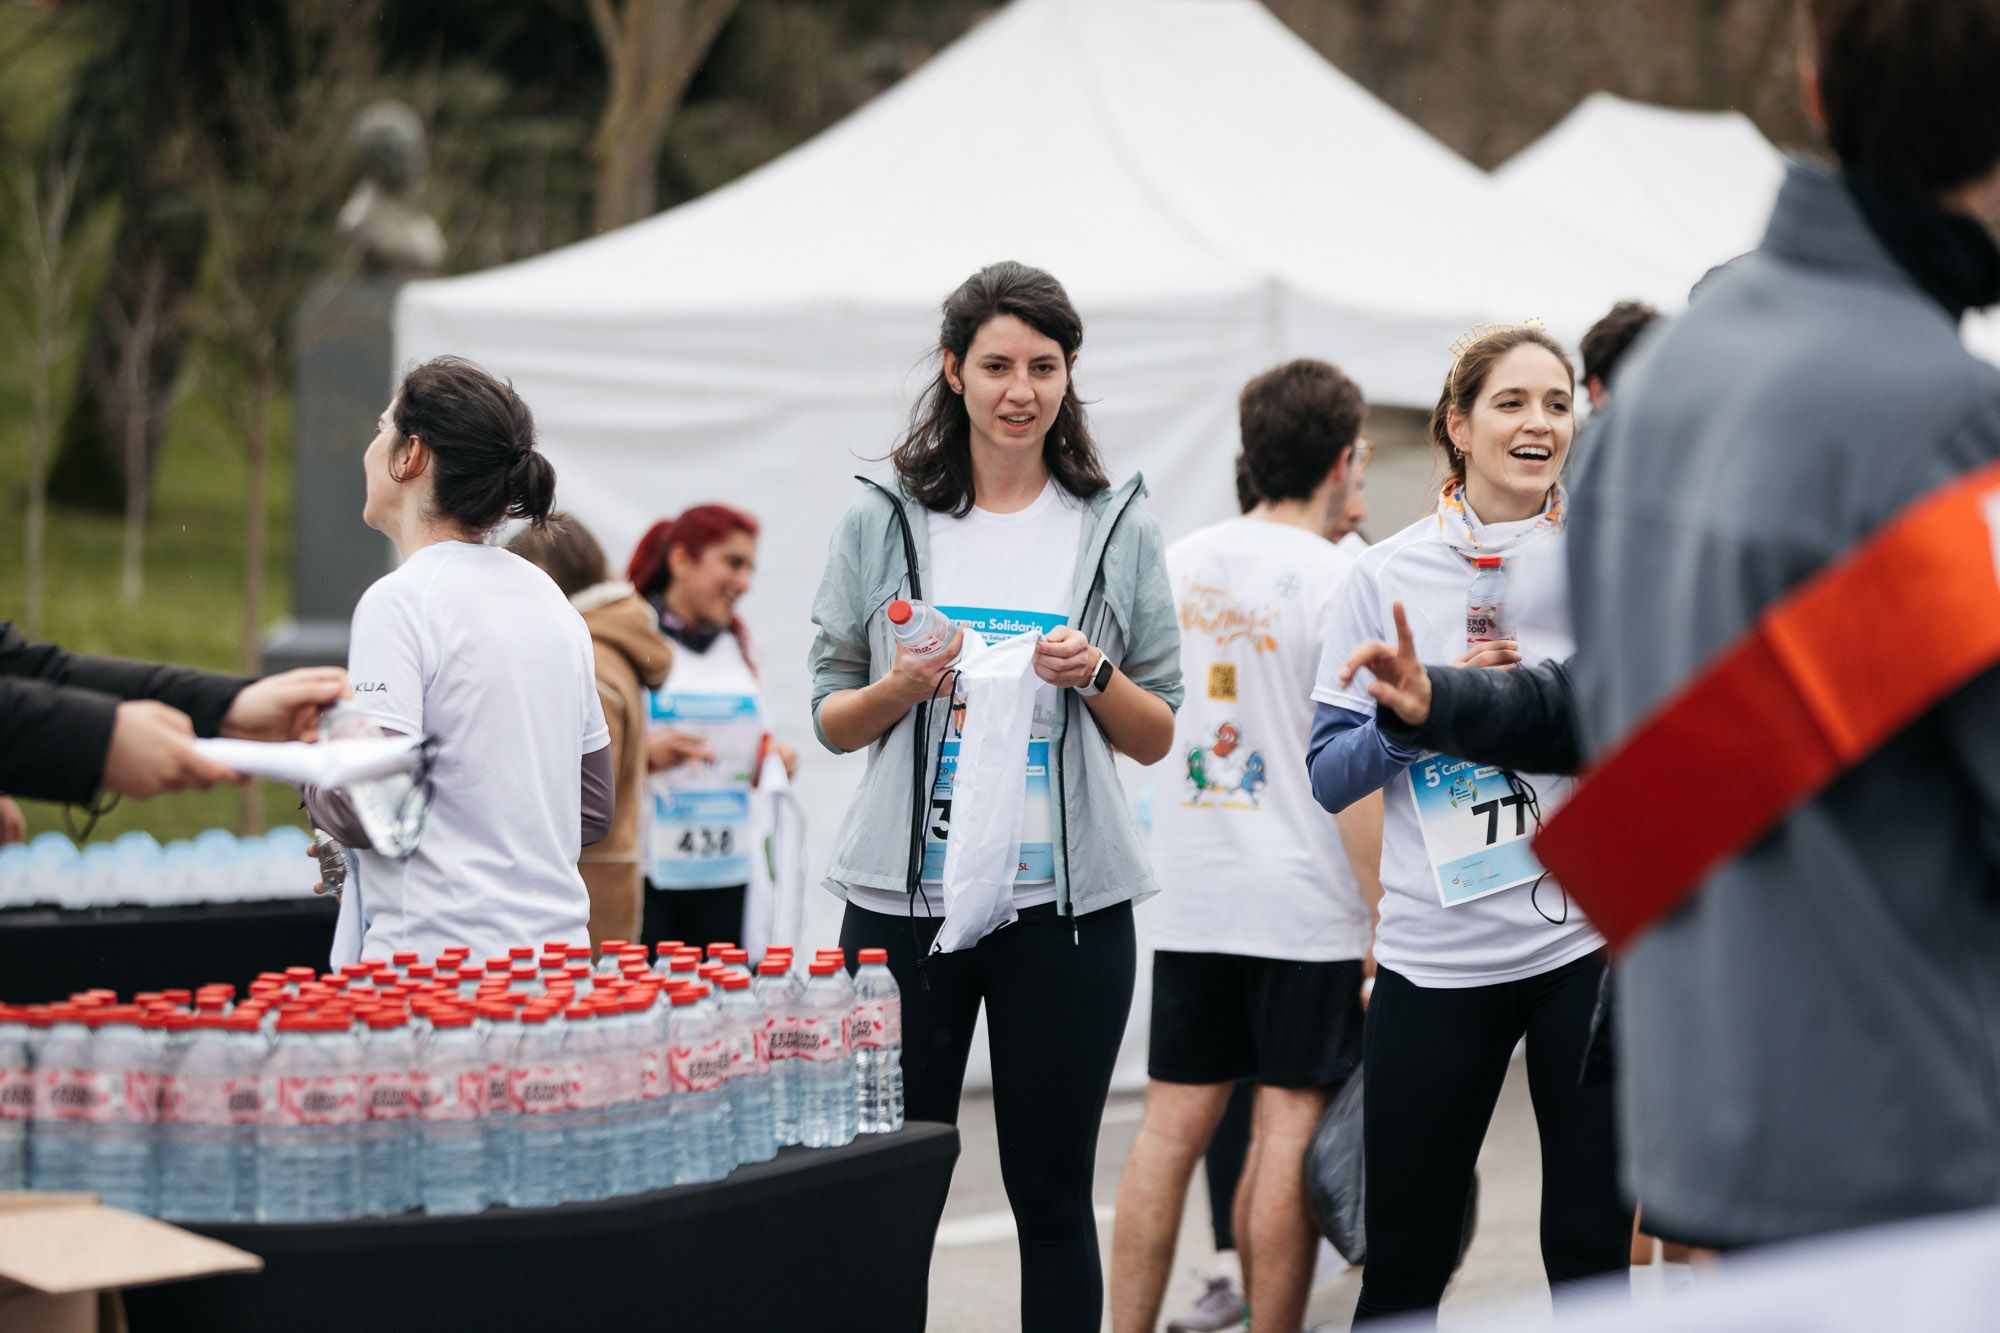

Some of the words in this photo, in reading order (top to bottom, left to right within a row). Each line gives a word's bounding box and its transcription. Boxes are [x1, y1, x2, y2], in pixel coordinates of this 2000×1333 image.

[989, 618, 1043, 633] Solidaria
[1466, 626, 1487, 634] ODIO
[1441, 760, 1477, 776] Carre
[1470, 793, 1525, 846] 77
